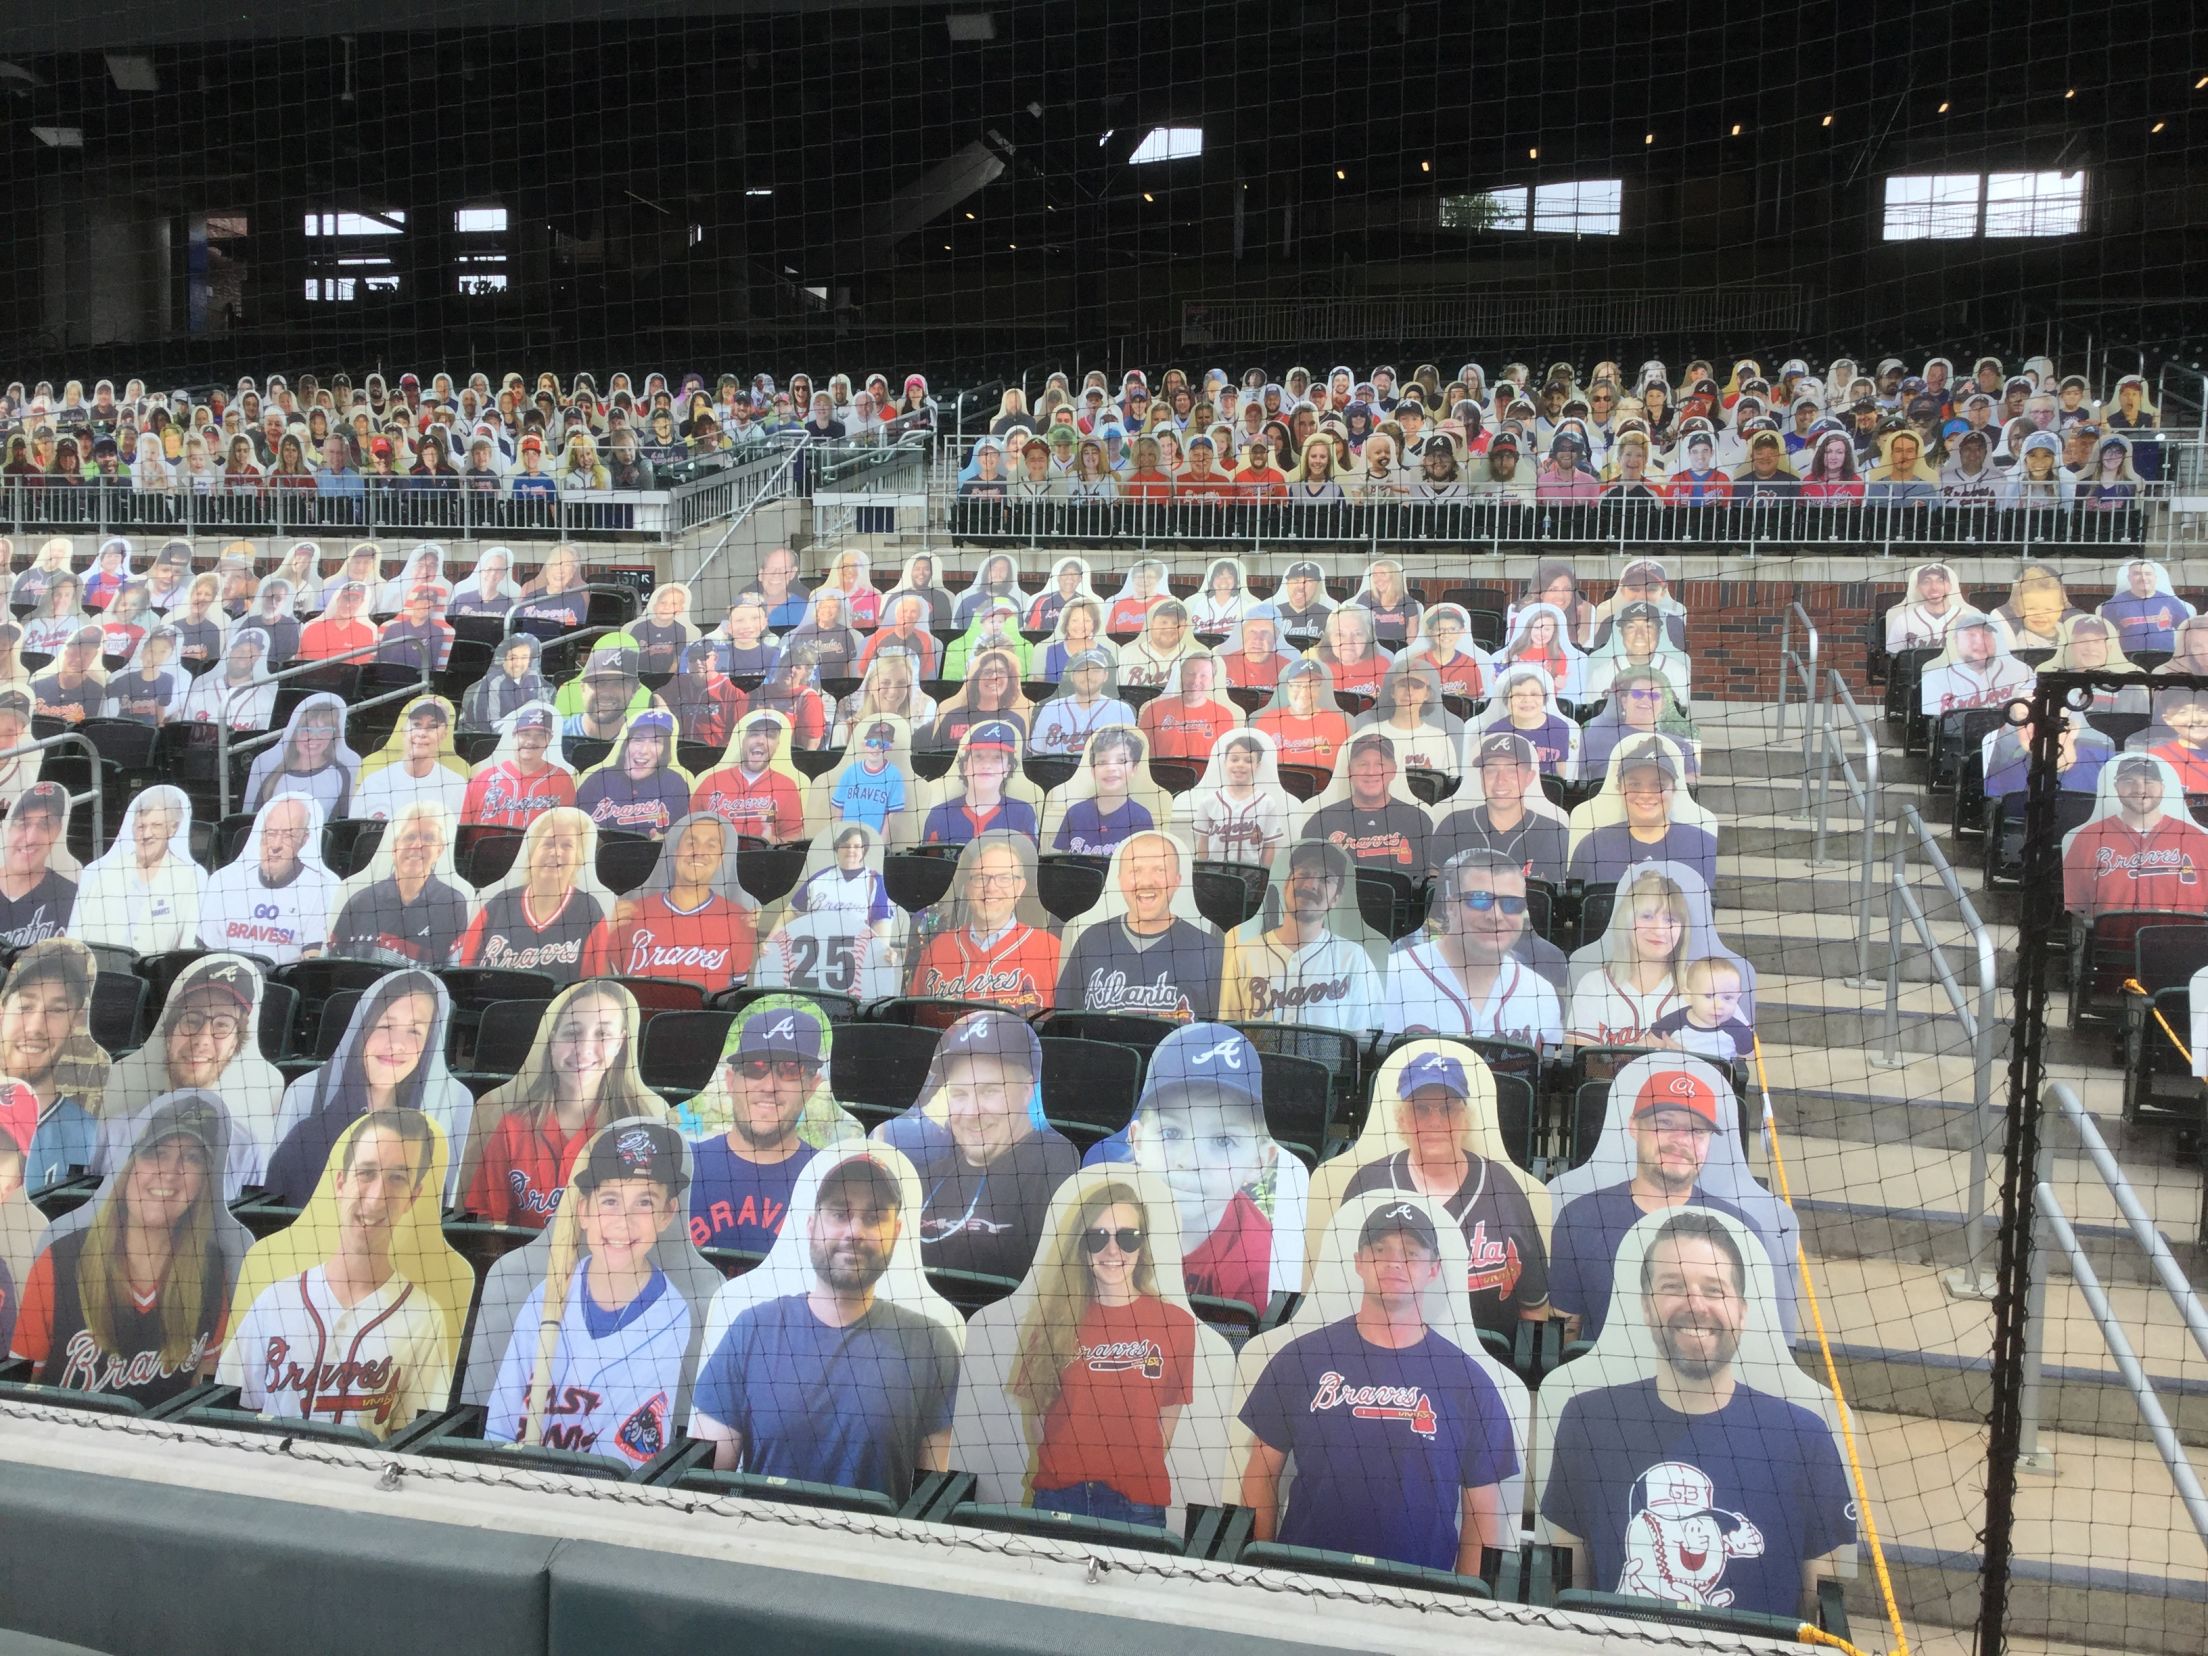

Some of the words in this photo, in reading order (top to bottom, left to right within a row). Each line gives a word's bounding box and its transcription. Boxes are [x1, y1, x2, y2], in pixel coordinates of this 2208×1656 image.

[602, 651, 622, 666] A
[847, 786, 888, 804] BRAVES
[592, 797, 661, 823] Braves
[1328, 830, 1401, 851] Braves
[2093, 846, 2181, 882] Braves
[254, 903, 281, 920] GO
[226, 922, 296, 945] BRAVES!
[480, 934, 583, 969] Braves
[626, 929, 729, 976] Braves
[789, 934, 856, 990] 25
[926, 967, 1023, 998] Braves
[1084, 966, 1178, 1010] Atlanta
[1250, 975, 1350, 1018] Braves
[763, 1015, 794, 1040] A
[960, 1017, 988, 1042] A
[1191, 1036, 1241, 1069] A
[1421, 1056, 1448, 1072] A
[508, 1169, 562, 1213] Bra
[689, 1195, 785, 1247] BRAV
[1385, 1204, 1413, 1221] A
[1069, 1339, 1150, 1364] raves
[1309, 1370, 1420, 1413] Braves
